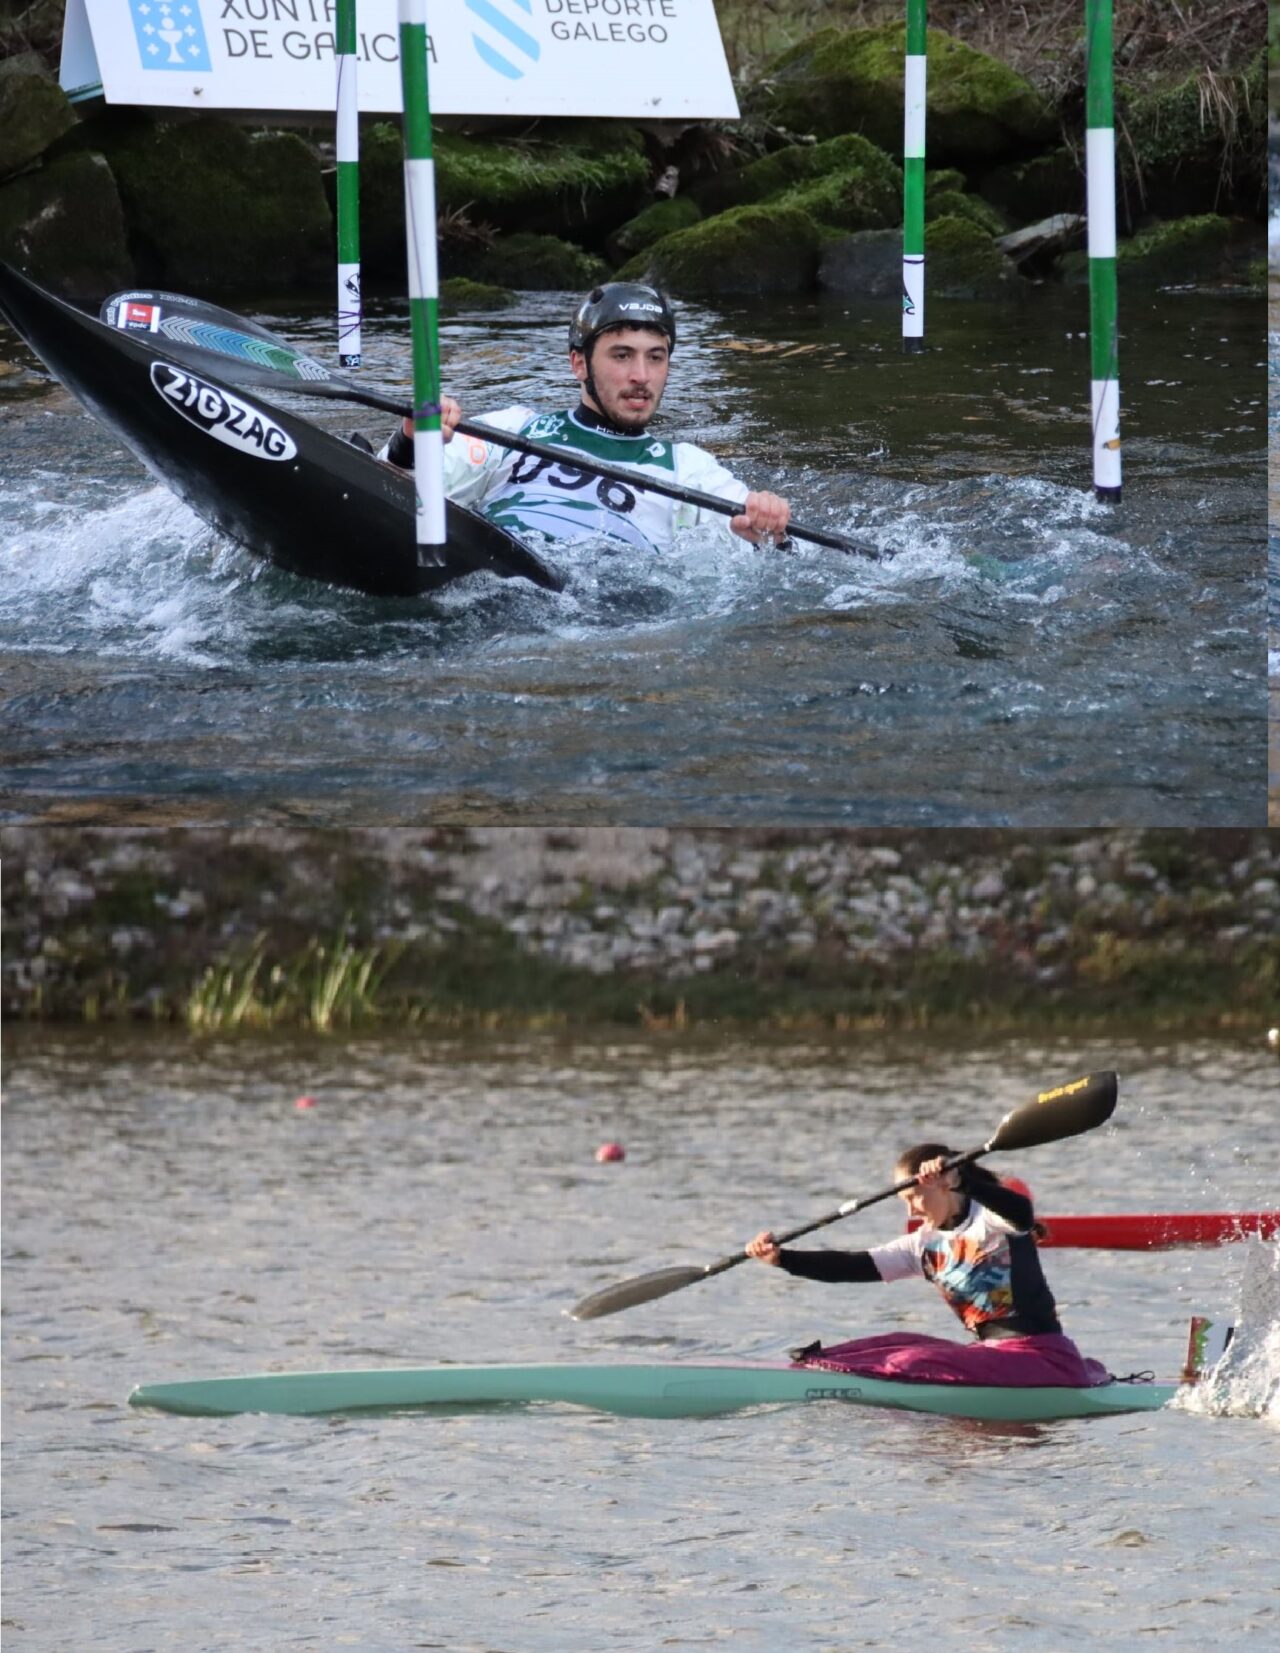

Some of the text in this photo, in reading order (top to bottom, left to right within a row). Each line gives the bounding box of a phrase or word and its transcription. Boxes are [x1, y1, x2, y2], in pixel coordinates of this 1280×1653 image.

[545, 0, 677, 17] DEPORTE
[551, 21, 668, 43] GALEGO
[223, 28, 438, 63] DE GAICA
